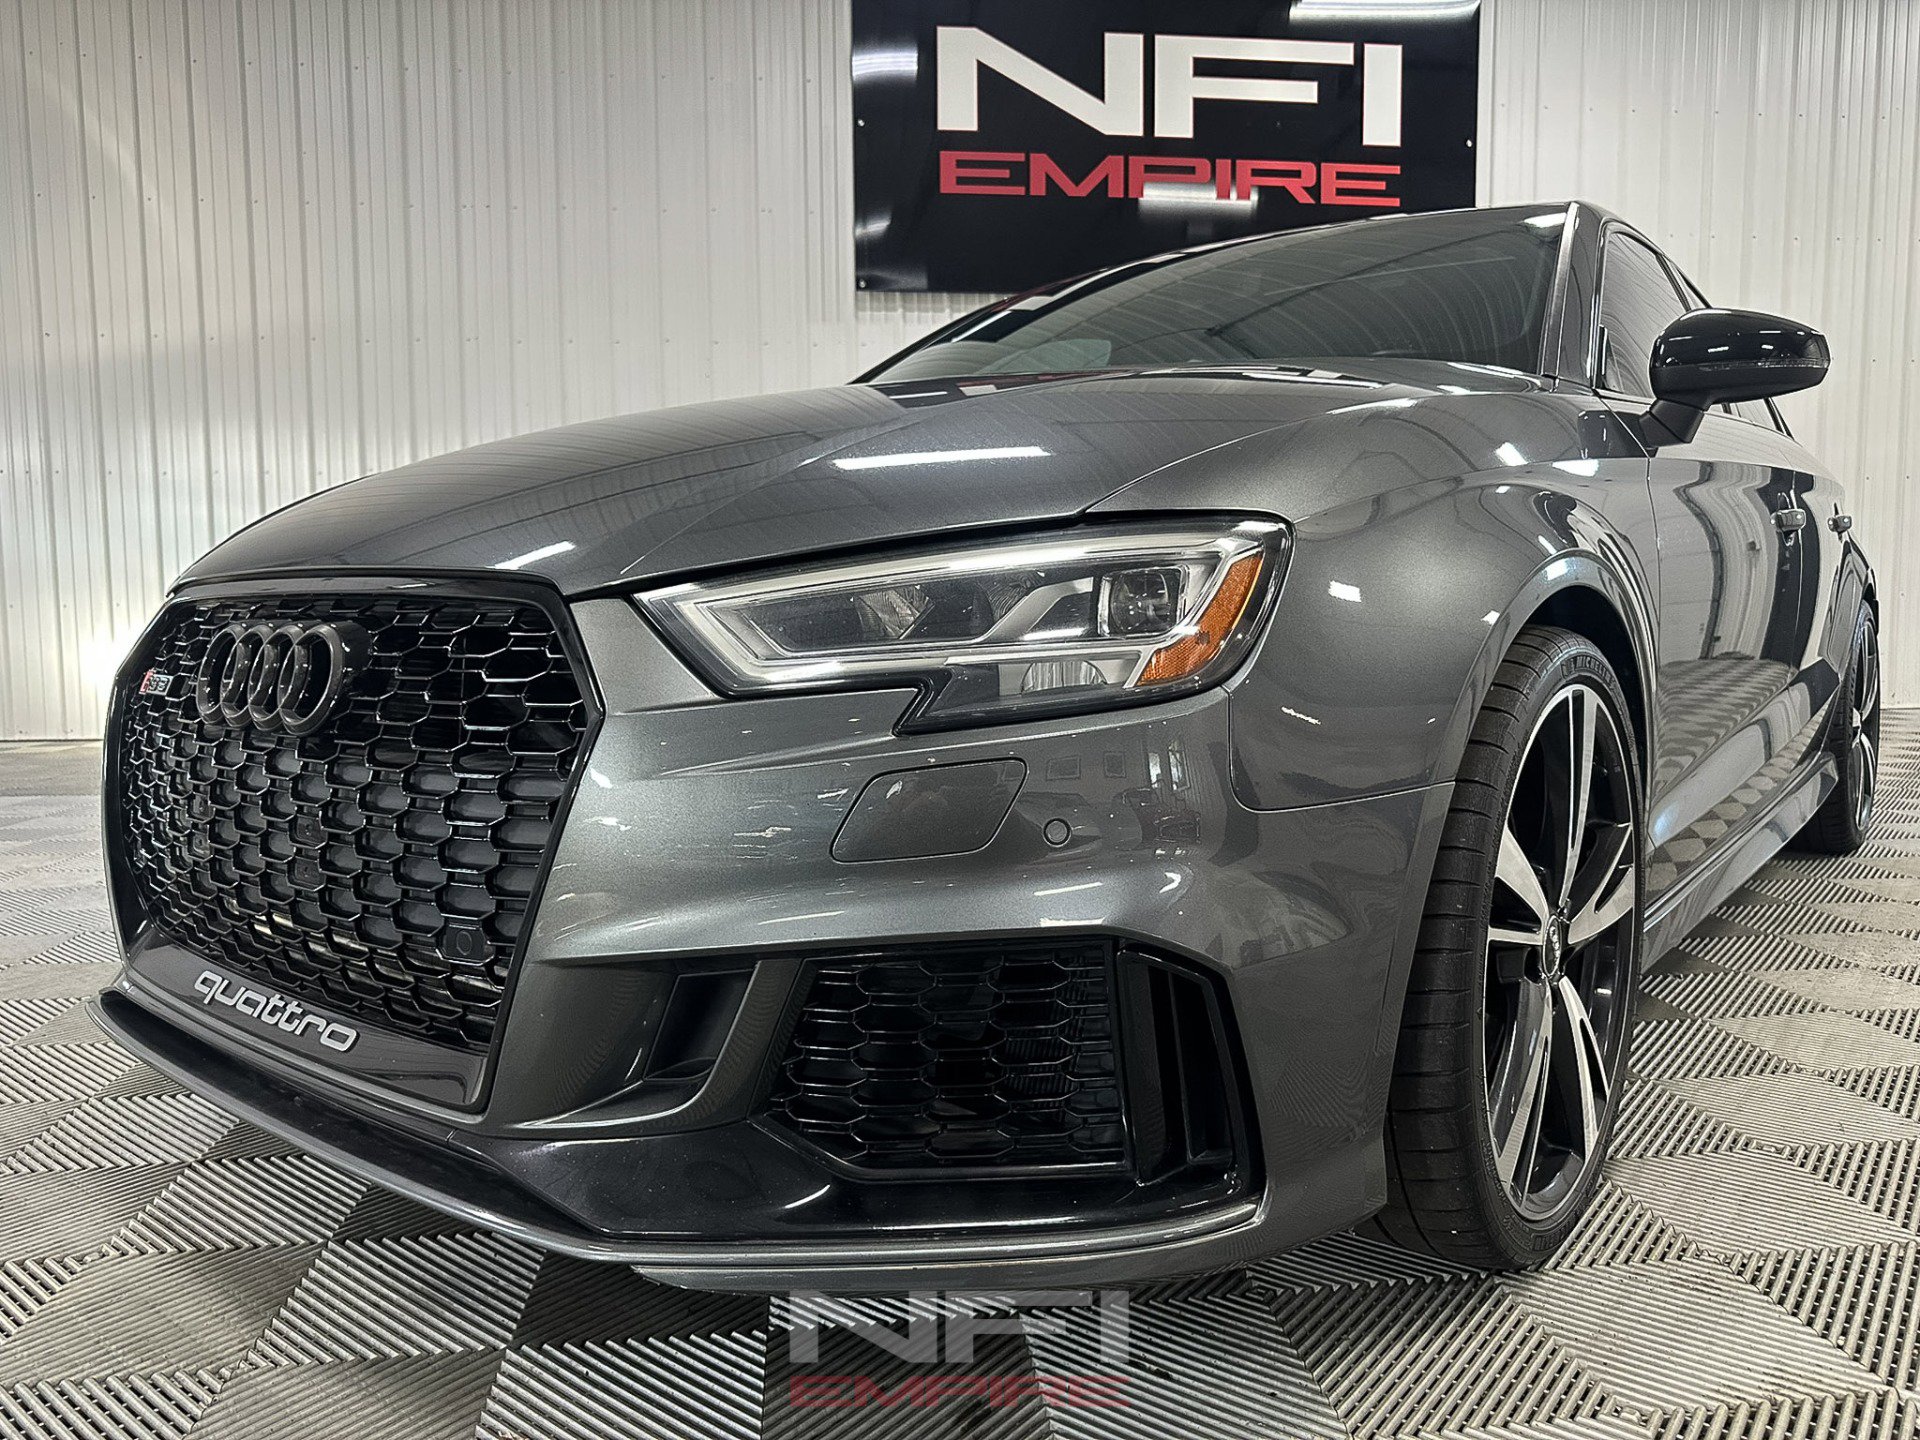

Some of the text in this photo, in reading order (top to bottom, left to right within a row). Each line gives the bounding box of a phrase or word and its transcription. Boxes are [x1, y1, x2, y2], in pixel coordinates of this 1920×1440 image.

[937, 26, 1402, 147] NFI
[938, 151, 1401, 207] EMPIRE
[194, 970, 358, 1052] quattro
